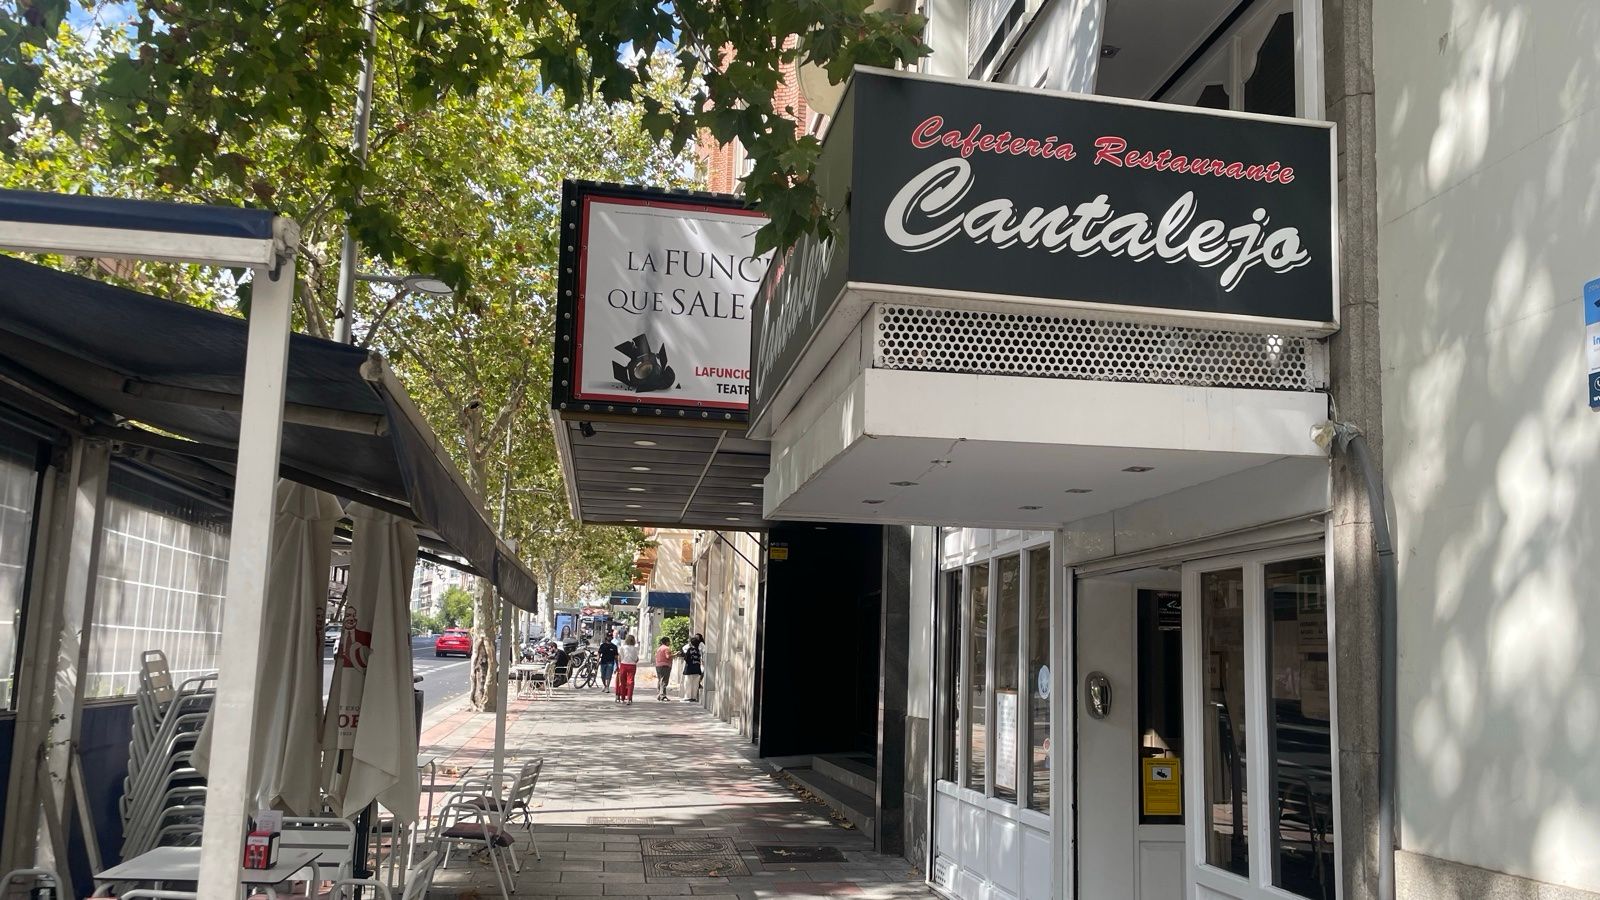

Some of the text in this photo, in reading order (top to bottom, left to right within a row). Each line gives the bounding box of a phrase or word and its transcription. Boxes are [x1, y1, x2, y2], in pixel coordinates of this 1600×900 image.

[911, 115, 1296, 184] Cafetería Restaurante
[884, 156, 1312, 293] Cantalejo
[627, 251, 658, 273] LA
[664, 249, 770, 284] FUNC
[607, 288, 745, 320] QUE SALE
